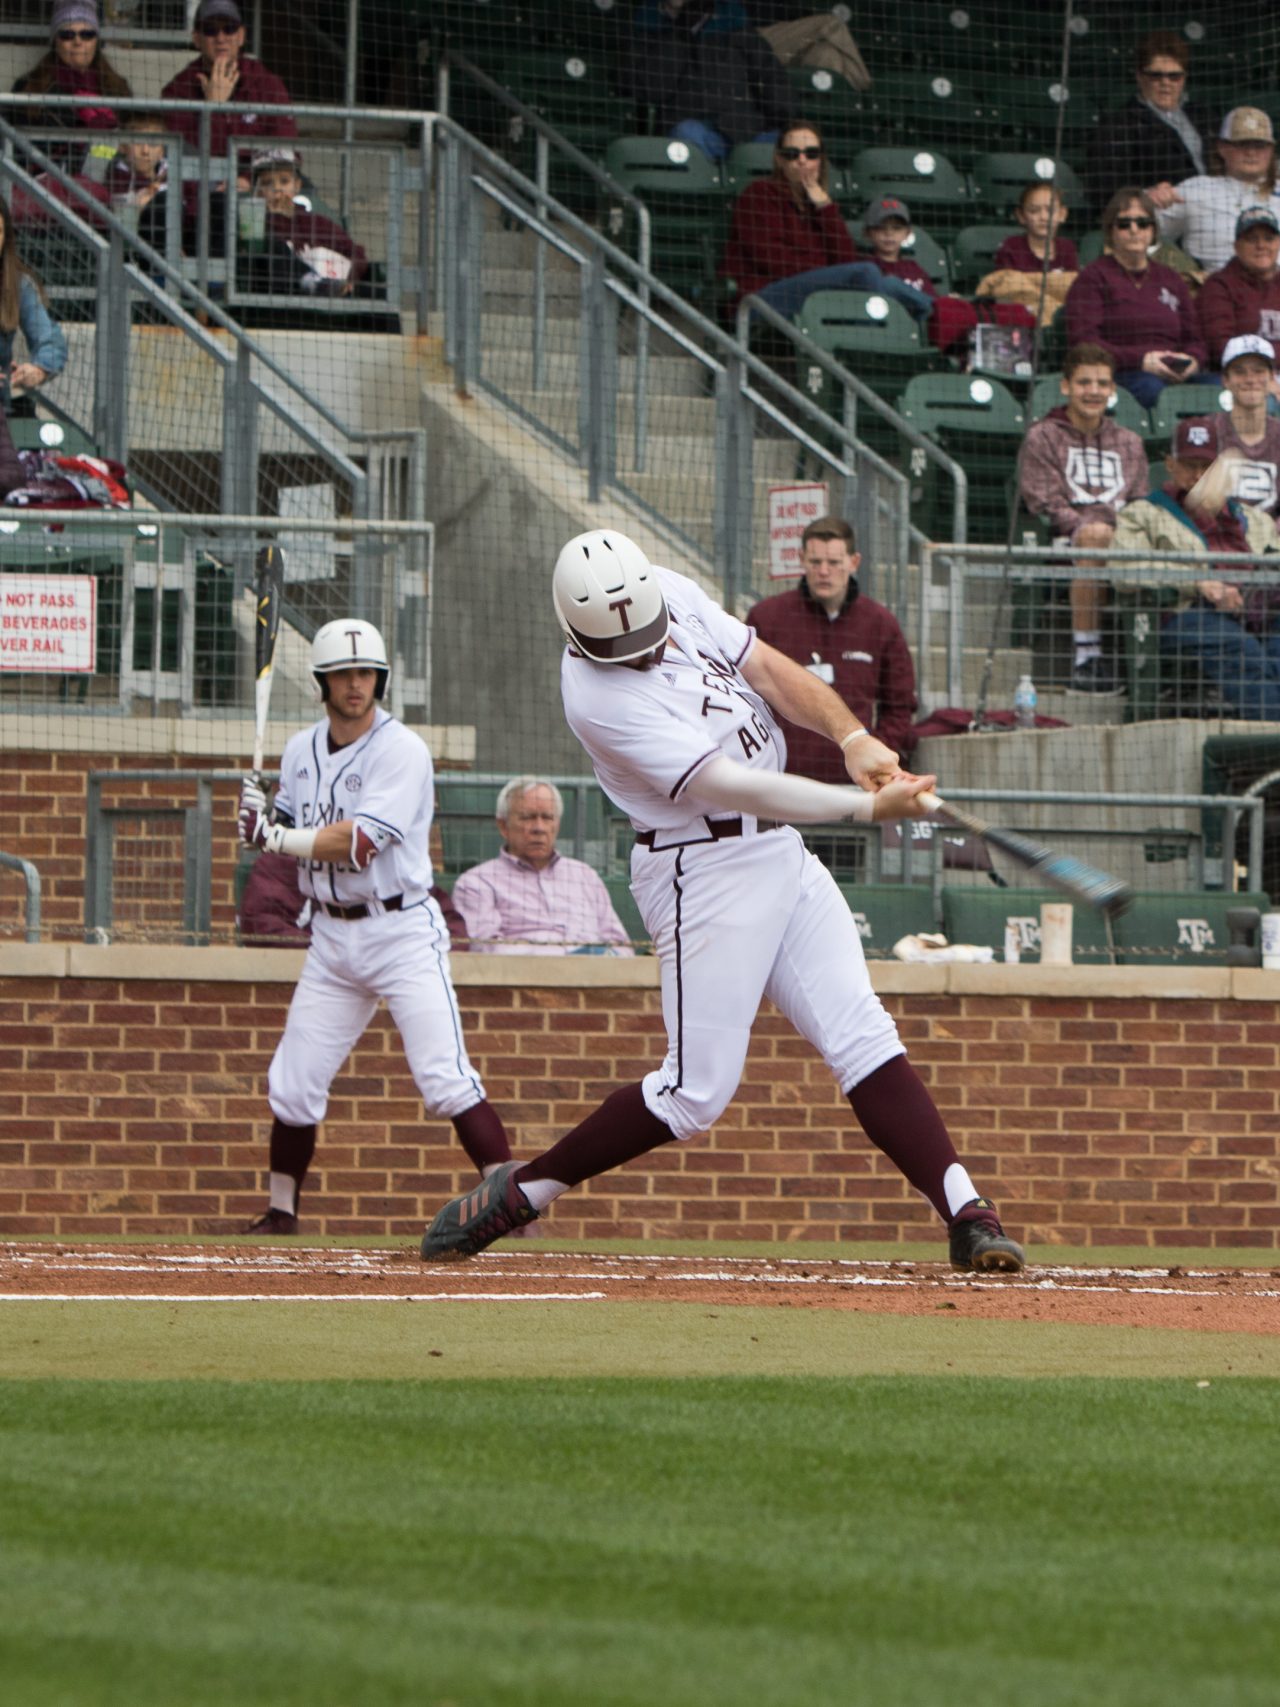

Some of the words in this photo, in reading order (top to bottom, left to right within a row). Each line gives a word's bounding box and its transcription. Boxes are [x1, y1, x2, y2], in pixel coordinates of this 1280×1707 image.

[6, 593, 34, 607] NOT
[40, 594, 75, 608] PASS
[609, 597, 633, 632] T
[3, 616, 87, 631] BEVERAGES
[0, 638, 28, 652] VER
[33, 638, 64, 654] RAIL
[345, 630, 361, 656] T
